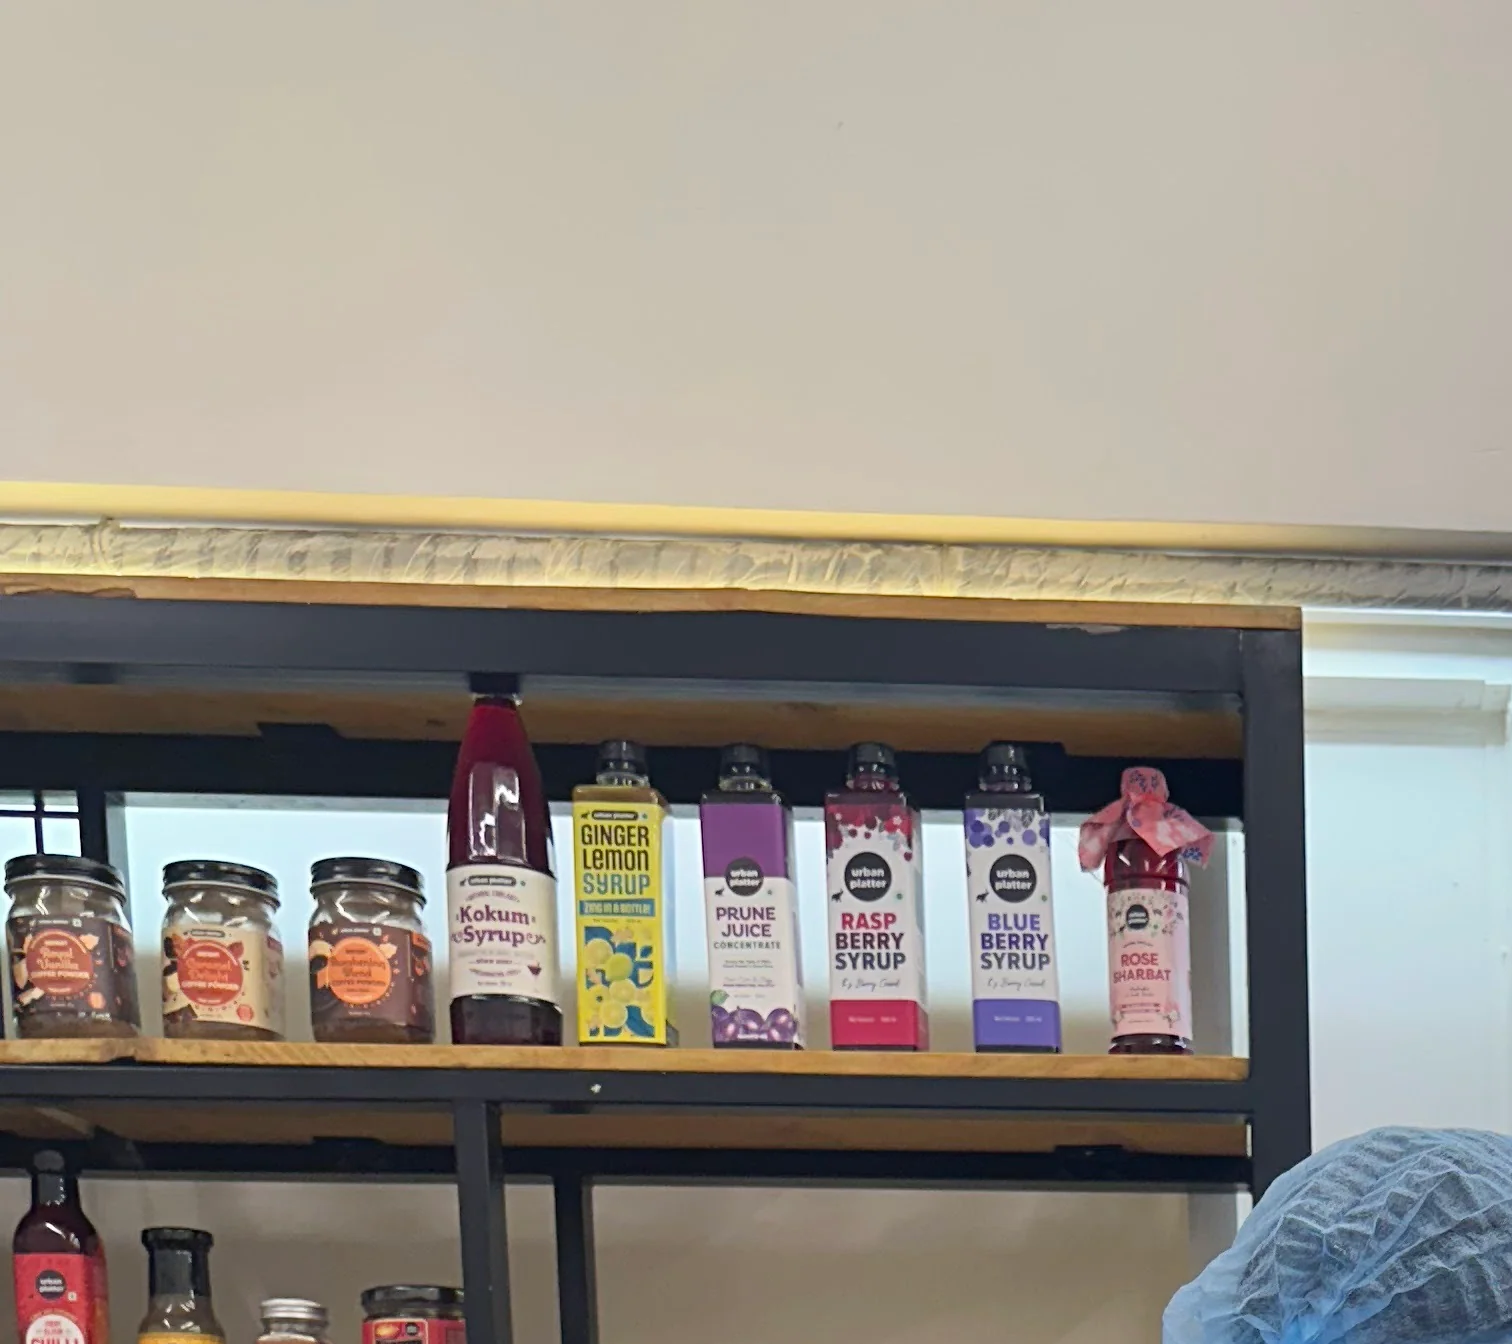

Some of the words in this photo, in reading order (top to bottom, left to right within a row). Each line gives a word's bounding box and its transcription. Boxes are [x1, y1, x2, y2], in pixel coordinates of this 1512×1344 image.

[581, 824, 649, 847] GINGER
[851, 866, 885, 878] urban
[996, 869, 1030, 879] urban
[850, 878, 887, 889] platter
[994, 880, 1033, 891] platter
[460, 904, 530, 925] Kokum
[716, 906, 776, 921] PRUNE
[841, 912, 897, 930] RASP
[988, 913, 1041, 931] BLUE
[463, 925, 525, 947] Syrup
[721, 924, 772, 938] JUICE
[713, 940, 781, 950] CONCENTRATE
[835, 932, 904, 950] BERRY
[980, 933, 1049, 951] BERRY
[835, 952, 906, 970] SYRUP
[980, 952, 1050, 970] SYRUP
[1120, 952, 1160, 967] ROSE
[1113, 968, 1172, 983] SHARBAT
